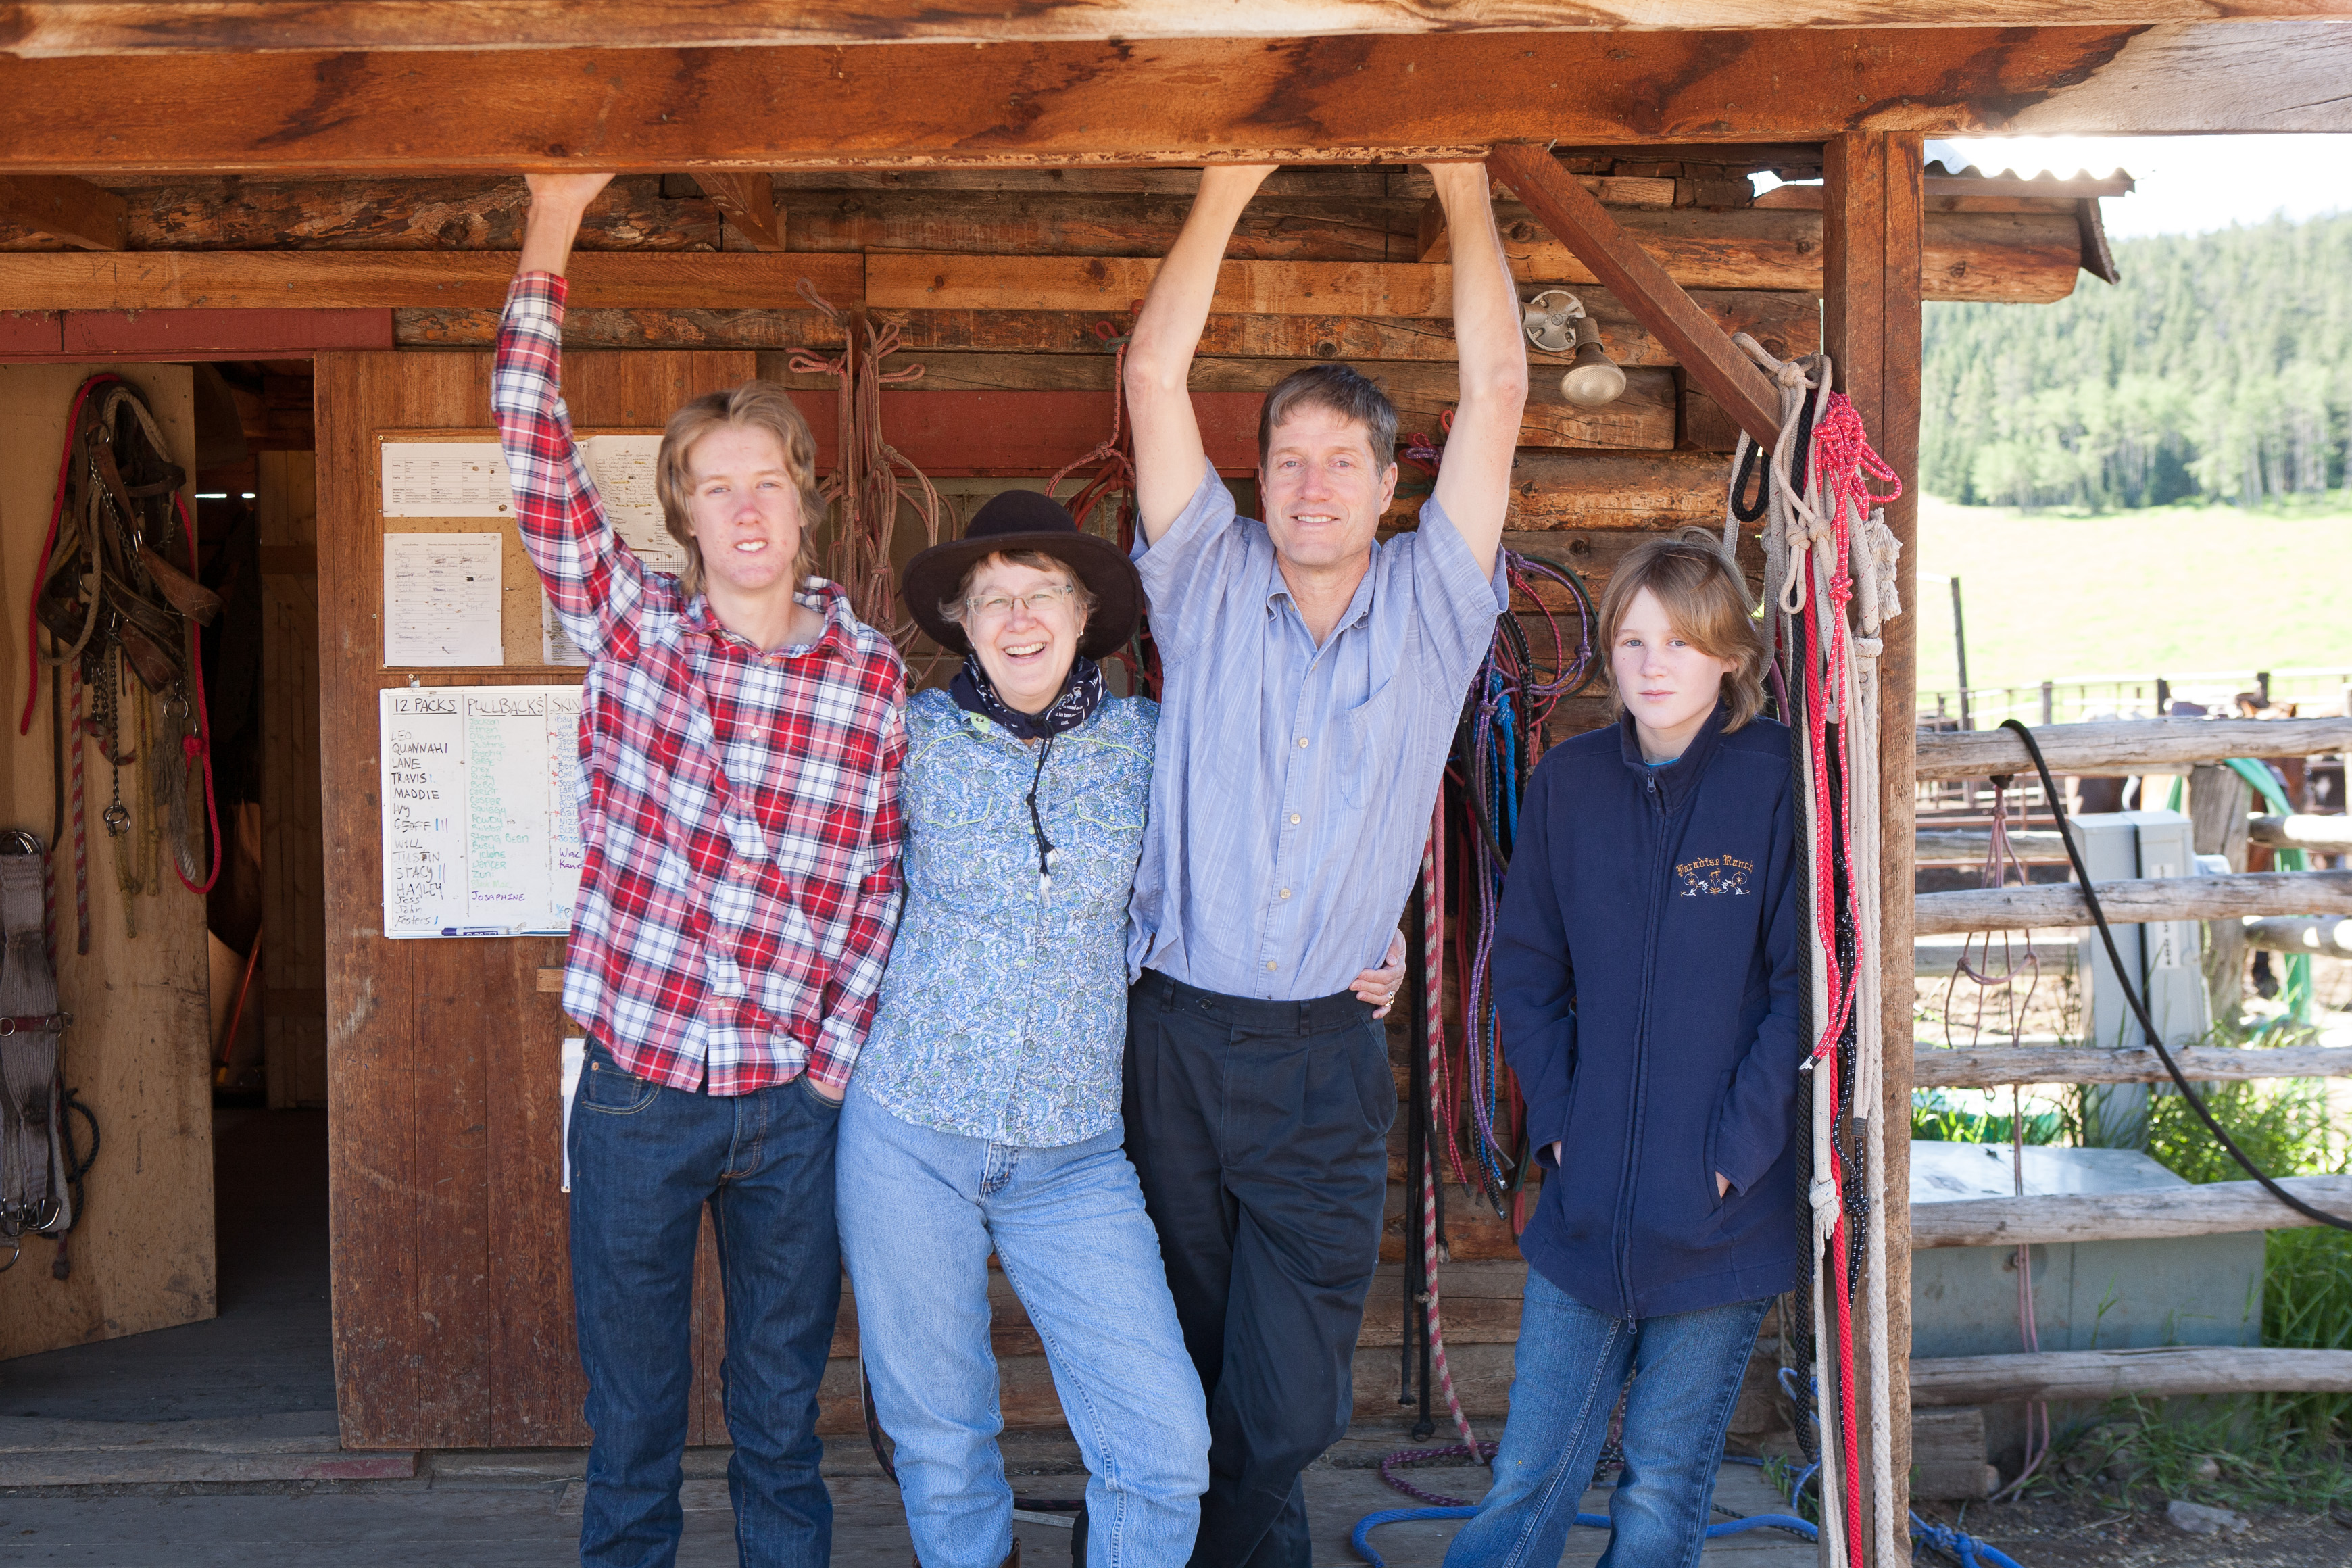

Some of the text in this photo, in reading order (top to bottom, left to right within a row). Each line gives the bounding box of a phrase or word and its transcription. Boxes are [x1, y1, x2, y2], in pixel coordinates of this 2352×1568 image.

[396, 698, 456, 712] 12 PACKS
[468, 697, 544, 715] PULLBACKS
[557, 715, 572, 725] Bay
[391, 730, 412, 741] LEO
[393, 743, 443, 755] QUANNAH
[392, 757, 421, 769] LANE
[391, 772, 427, 785] TRAVIS
[394, 787, 440, 800] MADDIE
[472, 841, 495, 852] Busy
[393, 850, 440, 863] JUSTIN
[1675, 854, 1754, 877] Paradise Ranch
[472, 891, 525, 901] JOSAPHINE
[395, 904, 422, 914] John
